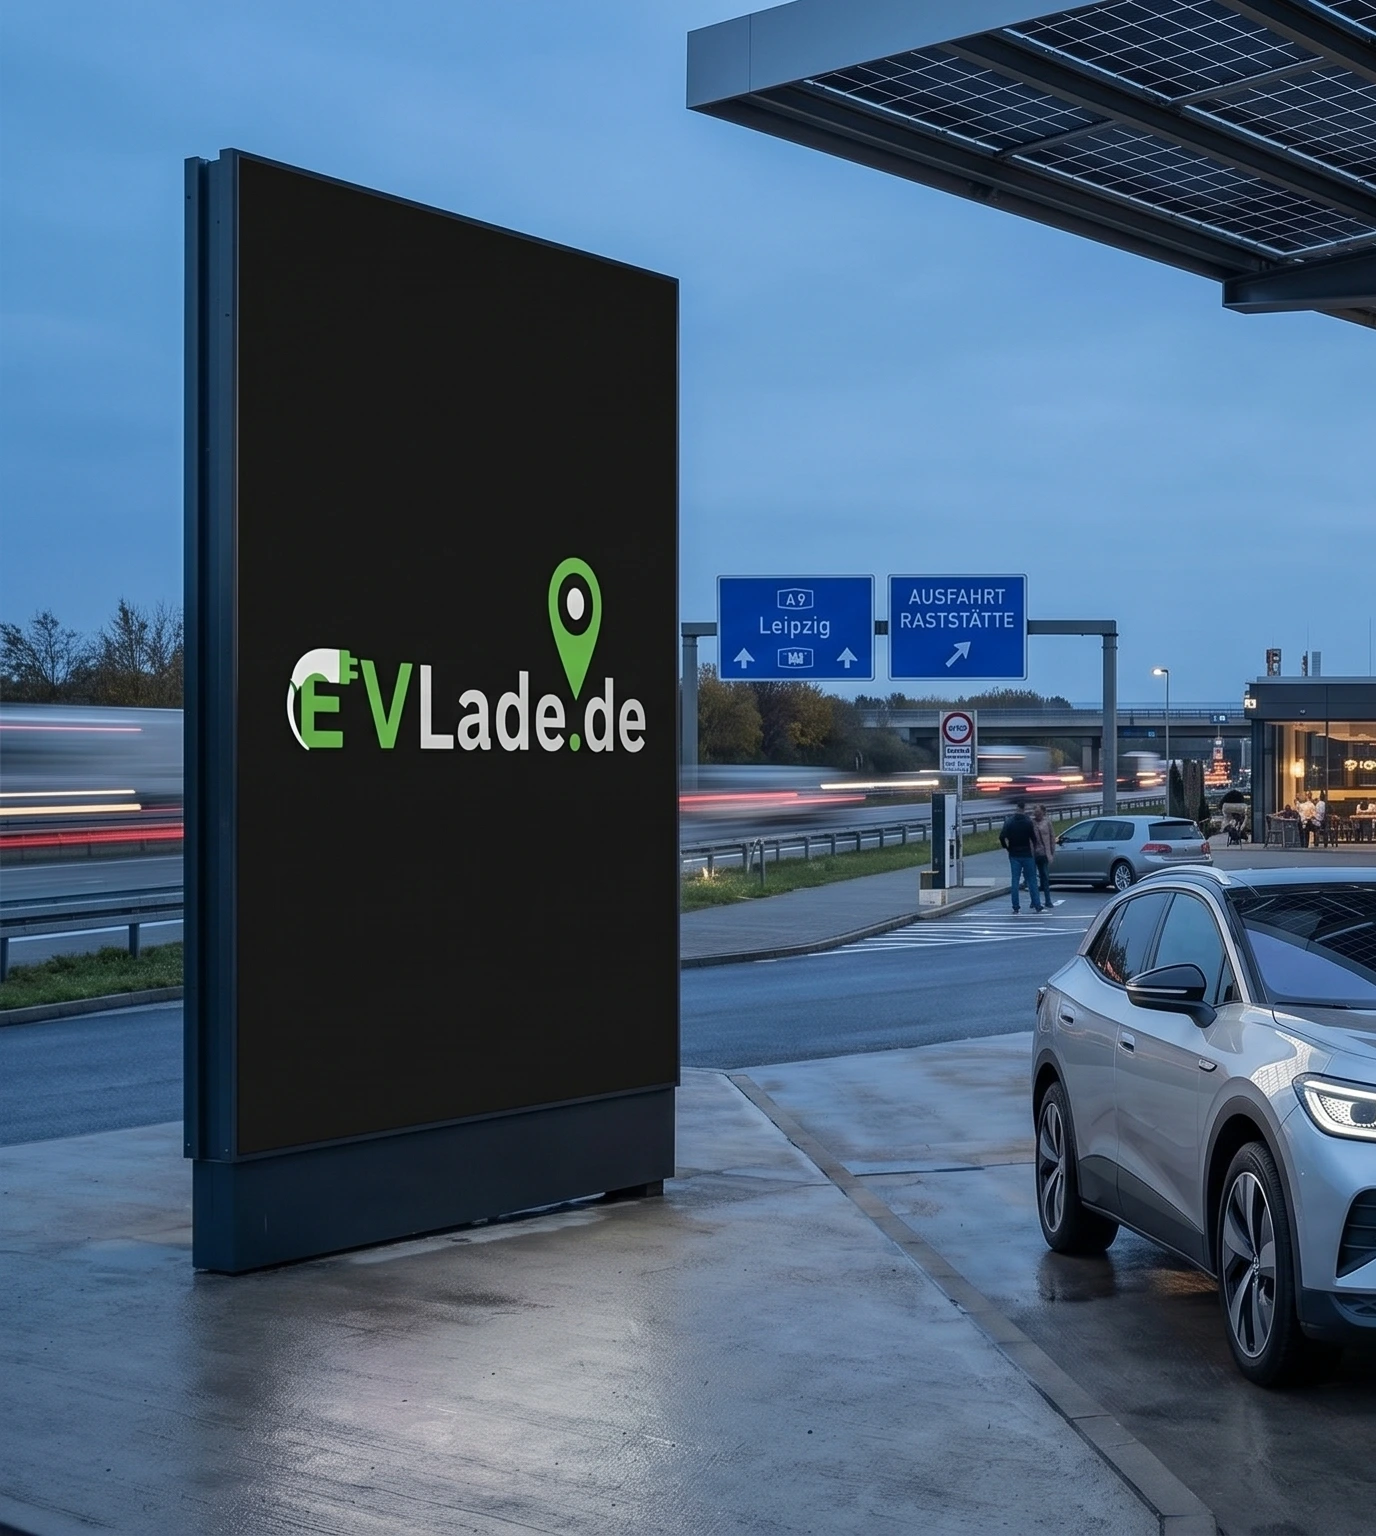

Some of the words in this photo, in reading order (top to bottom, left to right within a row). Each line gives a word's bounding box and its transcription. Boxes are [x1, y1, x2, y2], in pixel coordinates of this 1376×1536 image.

[908, 588, 1006, 605] AUSFAHRT
[760, 615, 830, 639] Leipzig
[900, 609, 1014, 629] RASTSTÄTTE
[287, 648, 646, 753] EVLade.de
